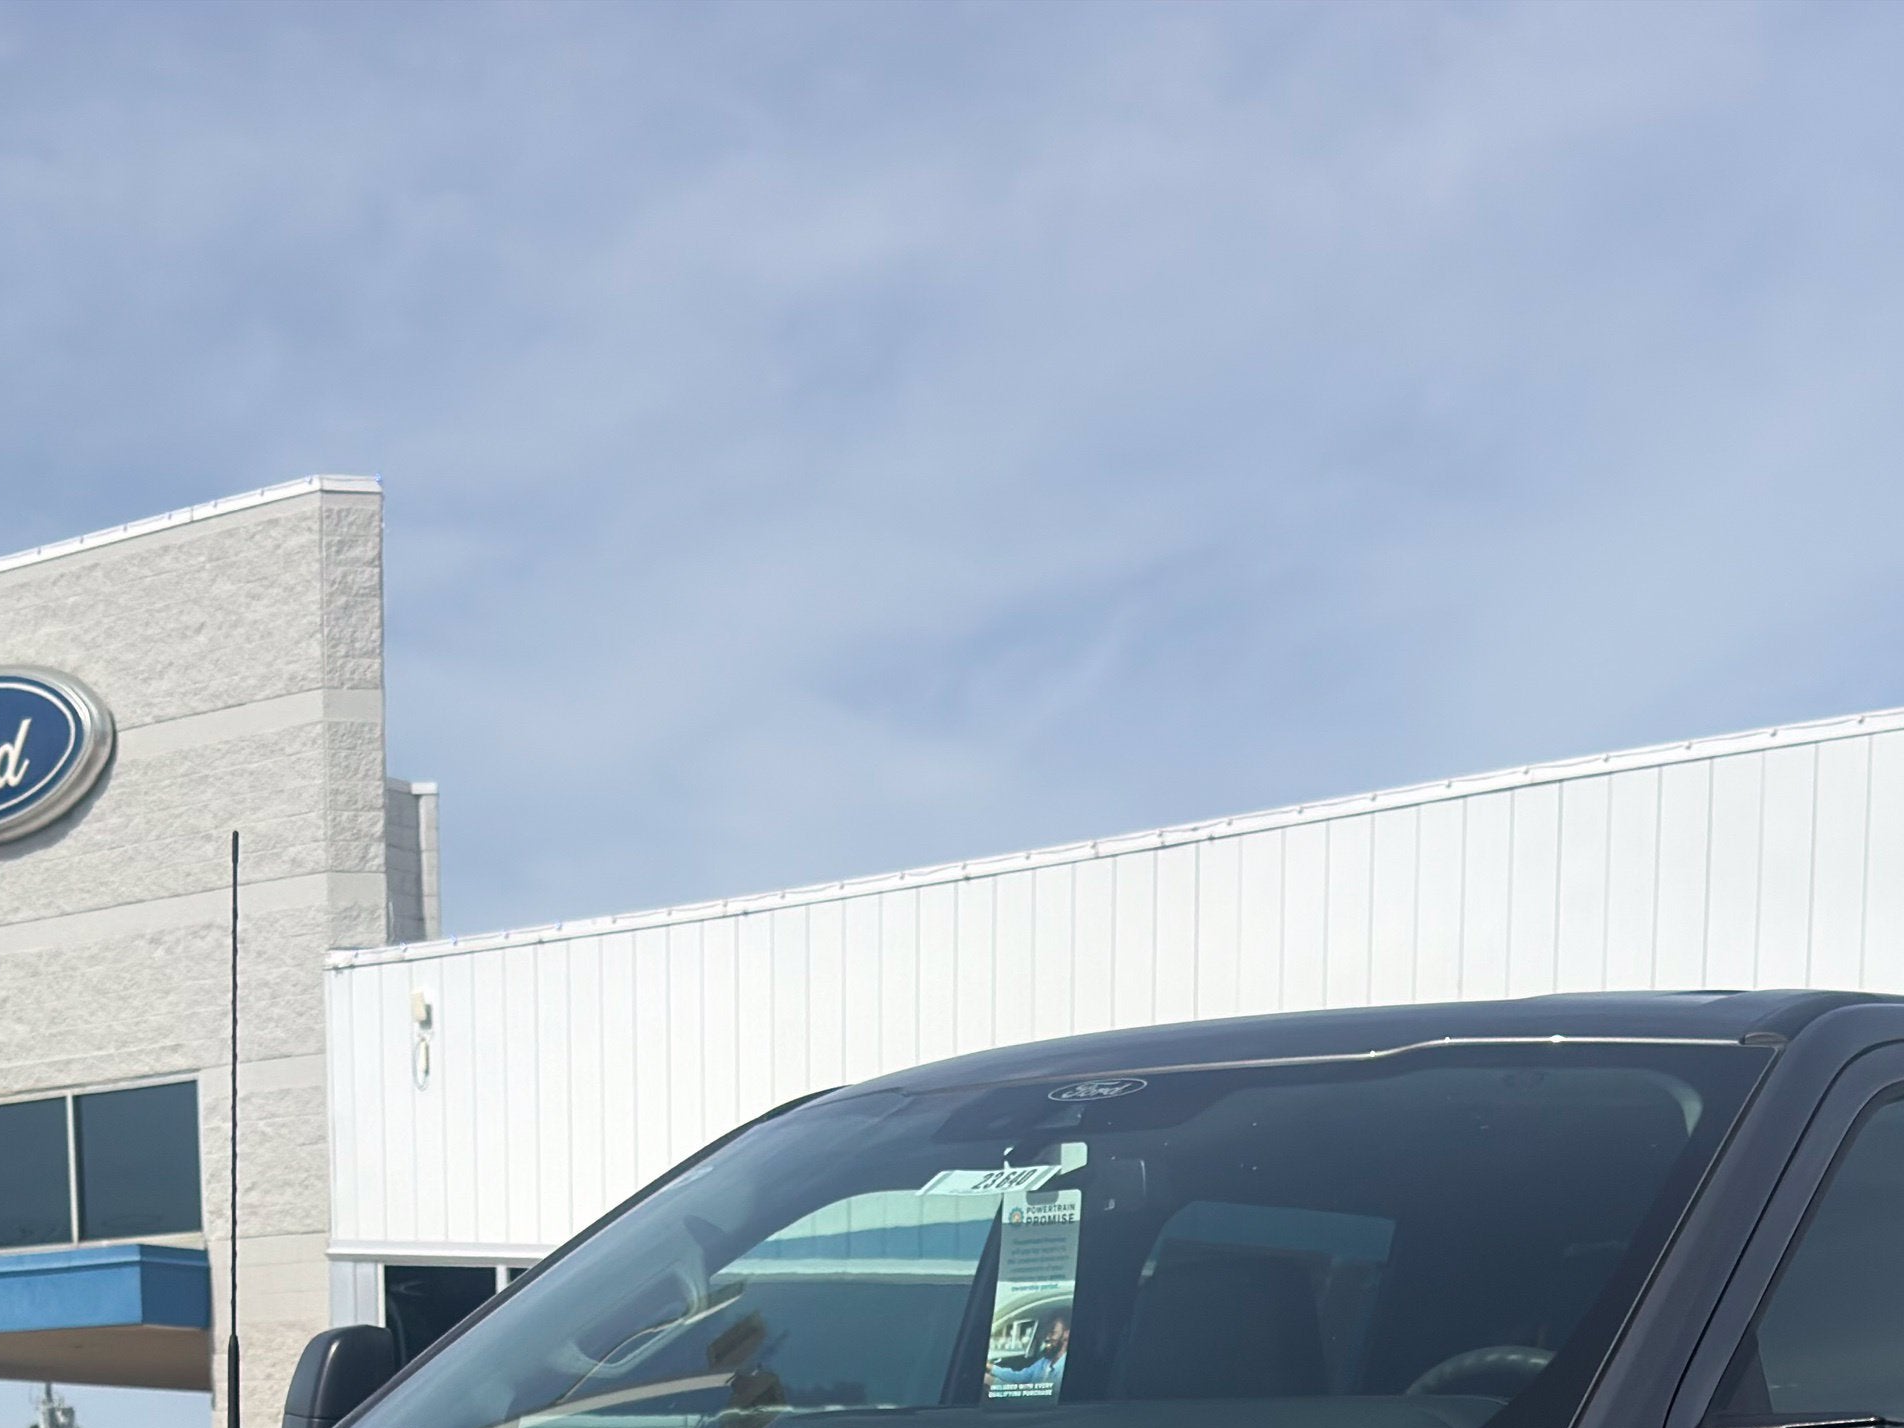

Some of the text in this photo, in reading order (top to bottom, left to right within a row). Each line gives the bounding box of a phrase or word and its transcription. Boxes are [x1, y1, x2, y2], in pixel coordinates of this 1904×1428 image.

[1061, 1081, 1133, 1099] Ford
[1026, 1203, 1076, 1214] POWERTRAIN
[1026, 1213, 1076, 1226] PROMISE
